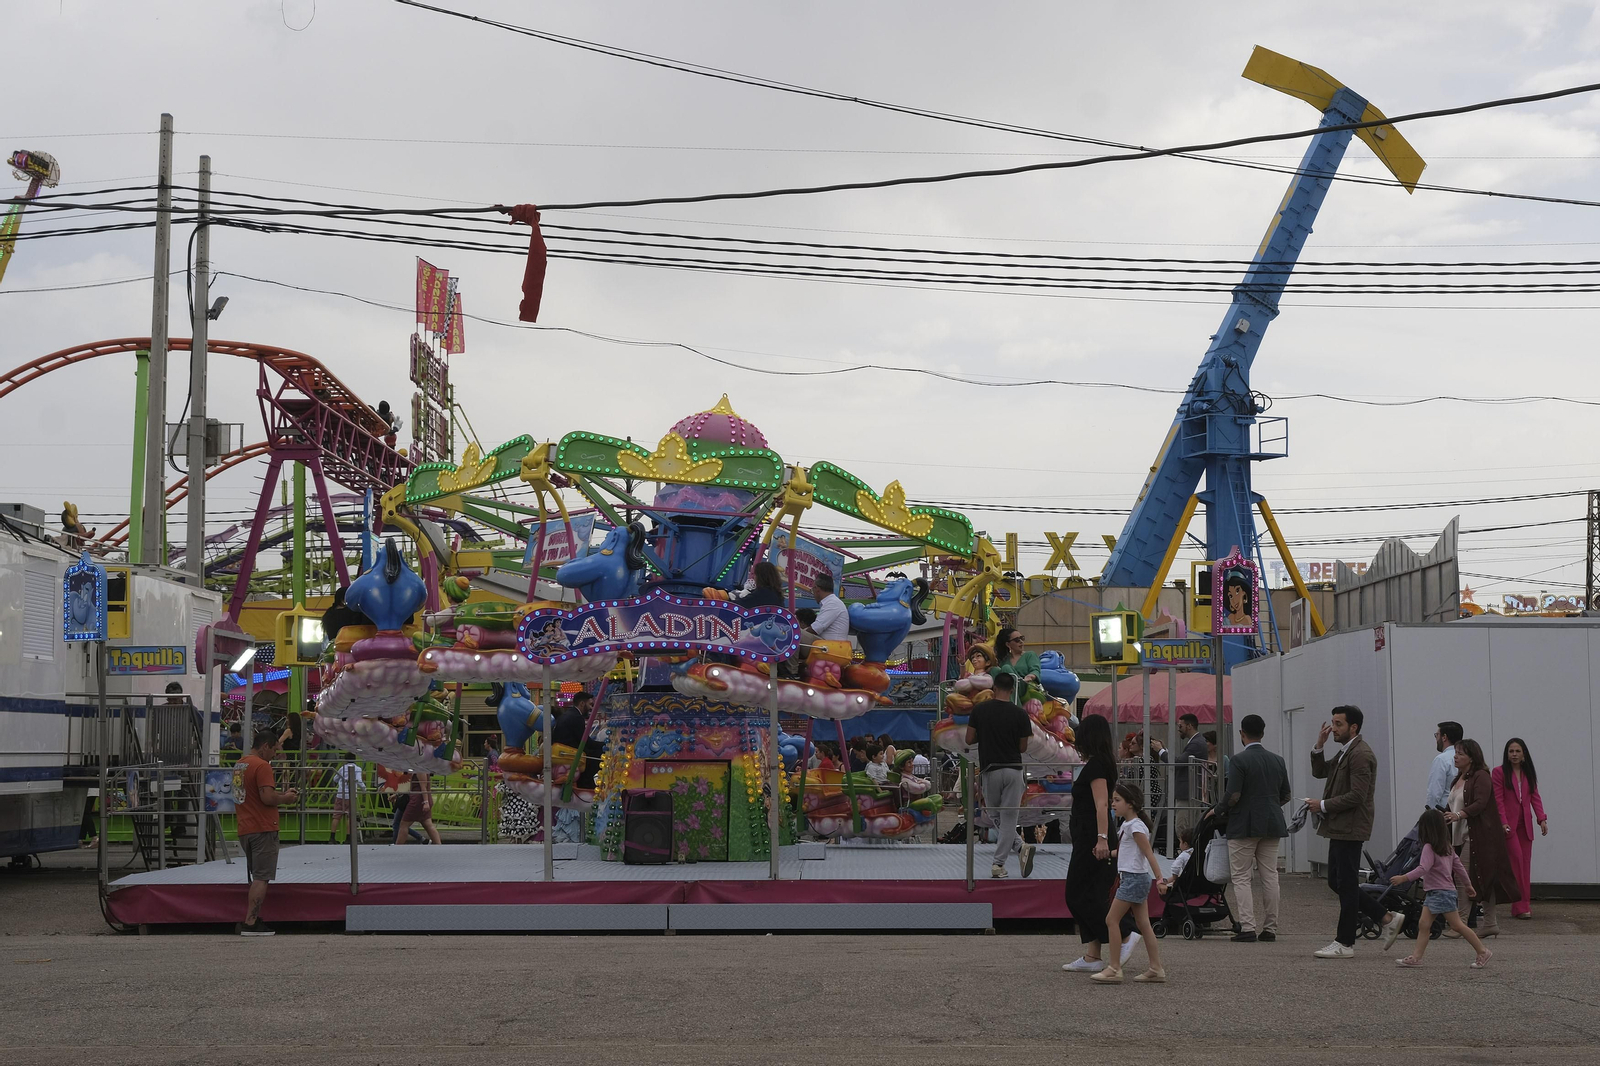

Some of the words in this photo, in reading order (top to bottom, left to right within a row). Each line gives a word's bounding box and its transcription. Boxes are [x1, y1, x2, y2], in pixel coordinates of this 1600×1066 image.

[572, 612, 741, 646] ALADIN
[110, 648, 184, 669] Taquilla
[1143, 641, 1210, 662] Taquilla
